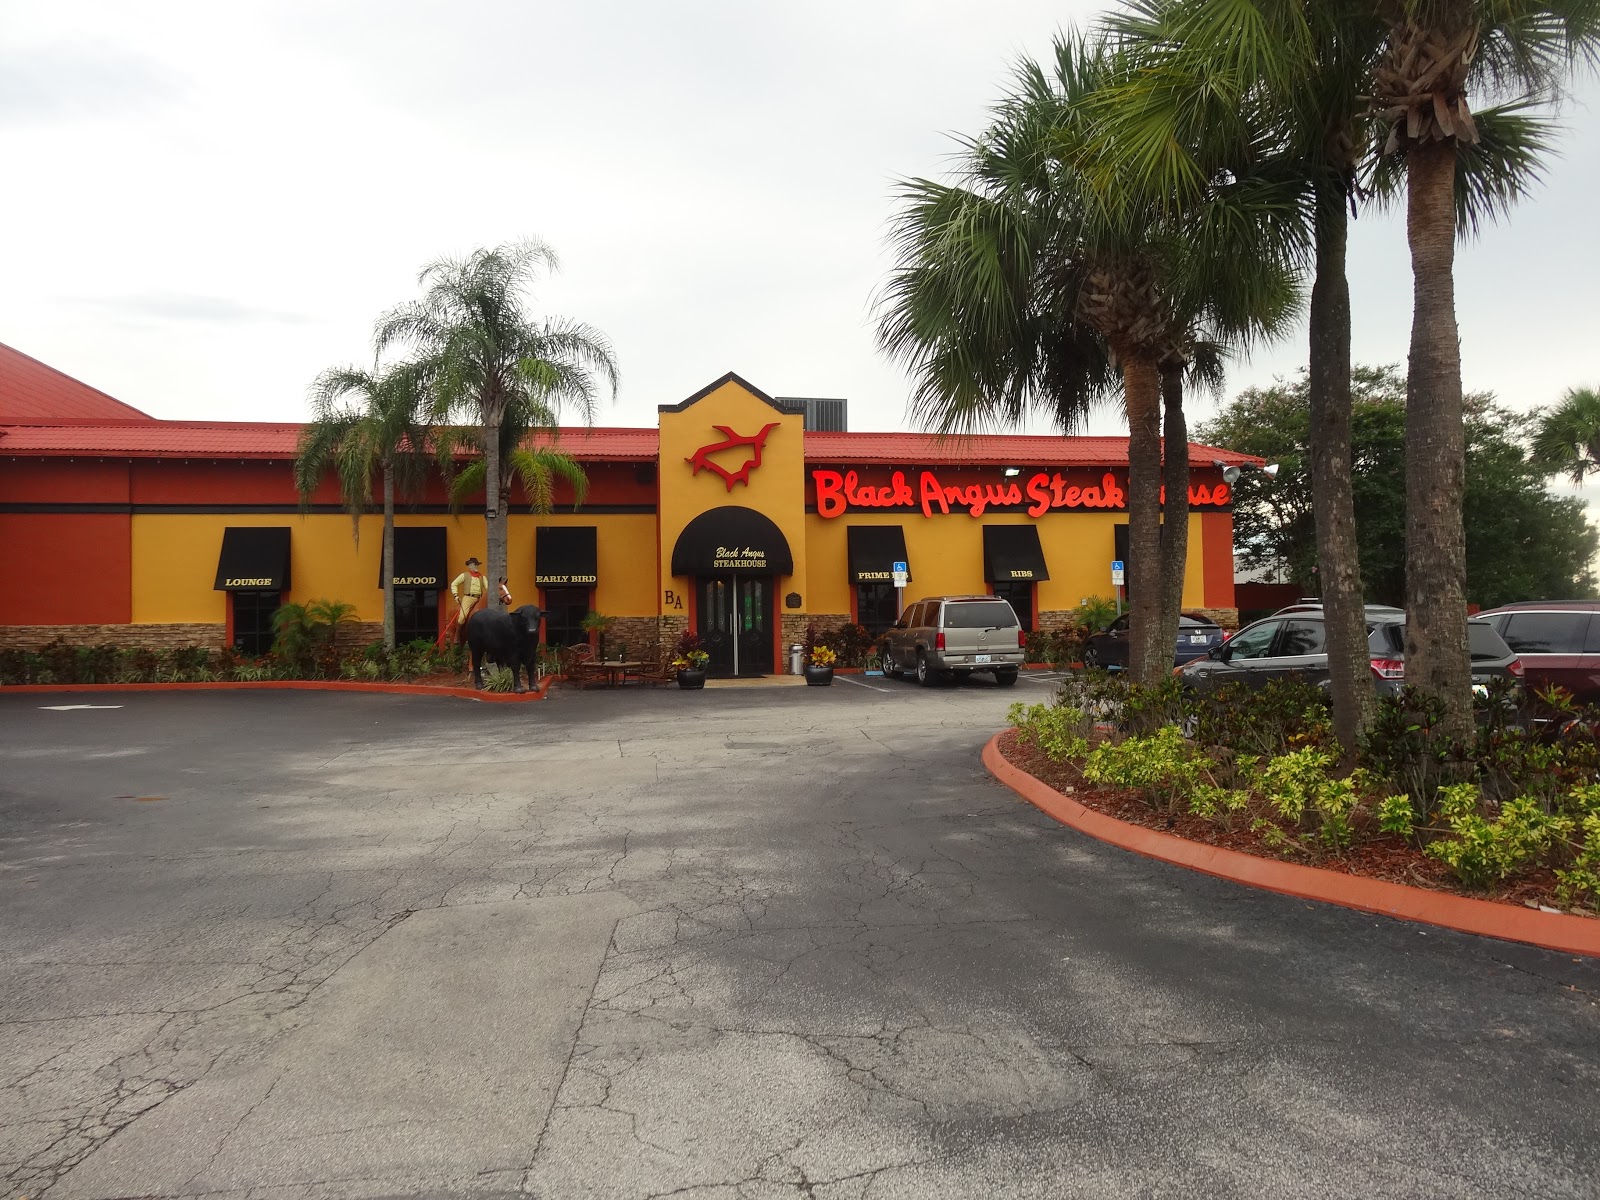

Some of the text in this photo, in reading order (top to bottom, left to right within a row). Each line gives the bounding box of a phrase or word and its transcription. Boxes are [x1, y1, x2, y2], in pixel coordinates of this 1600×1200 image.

[812, 470, 914, 518] Black
[920, 471, 1022, 518] Angus
[1026, 472, 1125, 518] Steak
[716, 546, 765, 560] Black Angus
[713, 559, 767, 568] STEAKHOUSE
[1010, 570, 1033, 578] RIBS
[225, 578, 272, 586] LOUNGE
[391, 576, 437, 585] EAFOOD
[535, 575, 597, 583] EARLY BIRD
